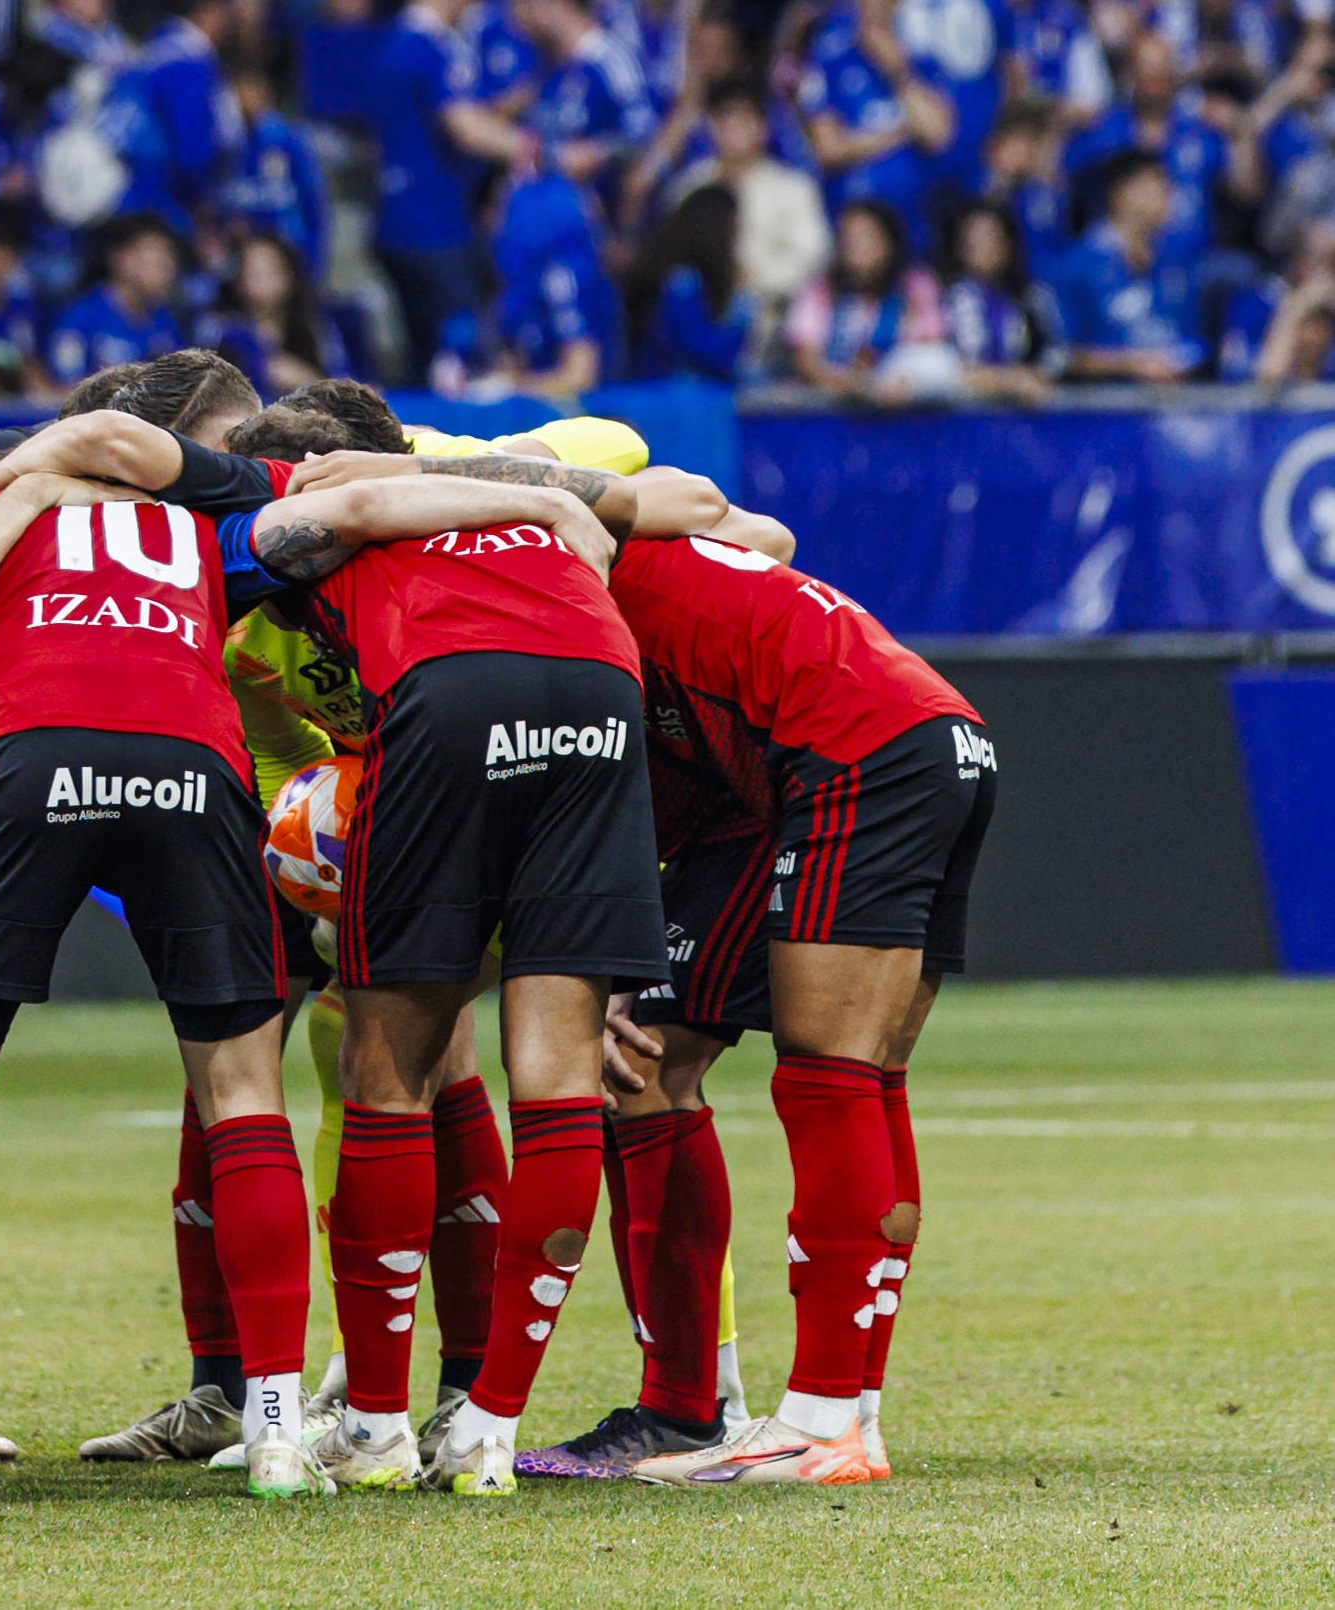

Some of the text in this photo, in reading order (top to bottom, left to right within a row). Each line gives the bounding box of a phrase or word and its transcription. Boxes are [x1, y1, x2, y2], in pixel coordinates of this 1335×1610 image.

[56, 501, 201, 590] 10
[26, 593, 200, 649] IZADI
[485, 717, 627, 765] Alucoil
[46, 766, 207, 814] Alucoil
[487, 768, 514, 780] Grupo
[46, 808, 121, 824] Grupo Alibérico
[262, 1390, 282, 1427] GU
